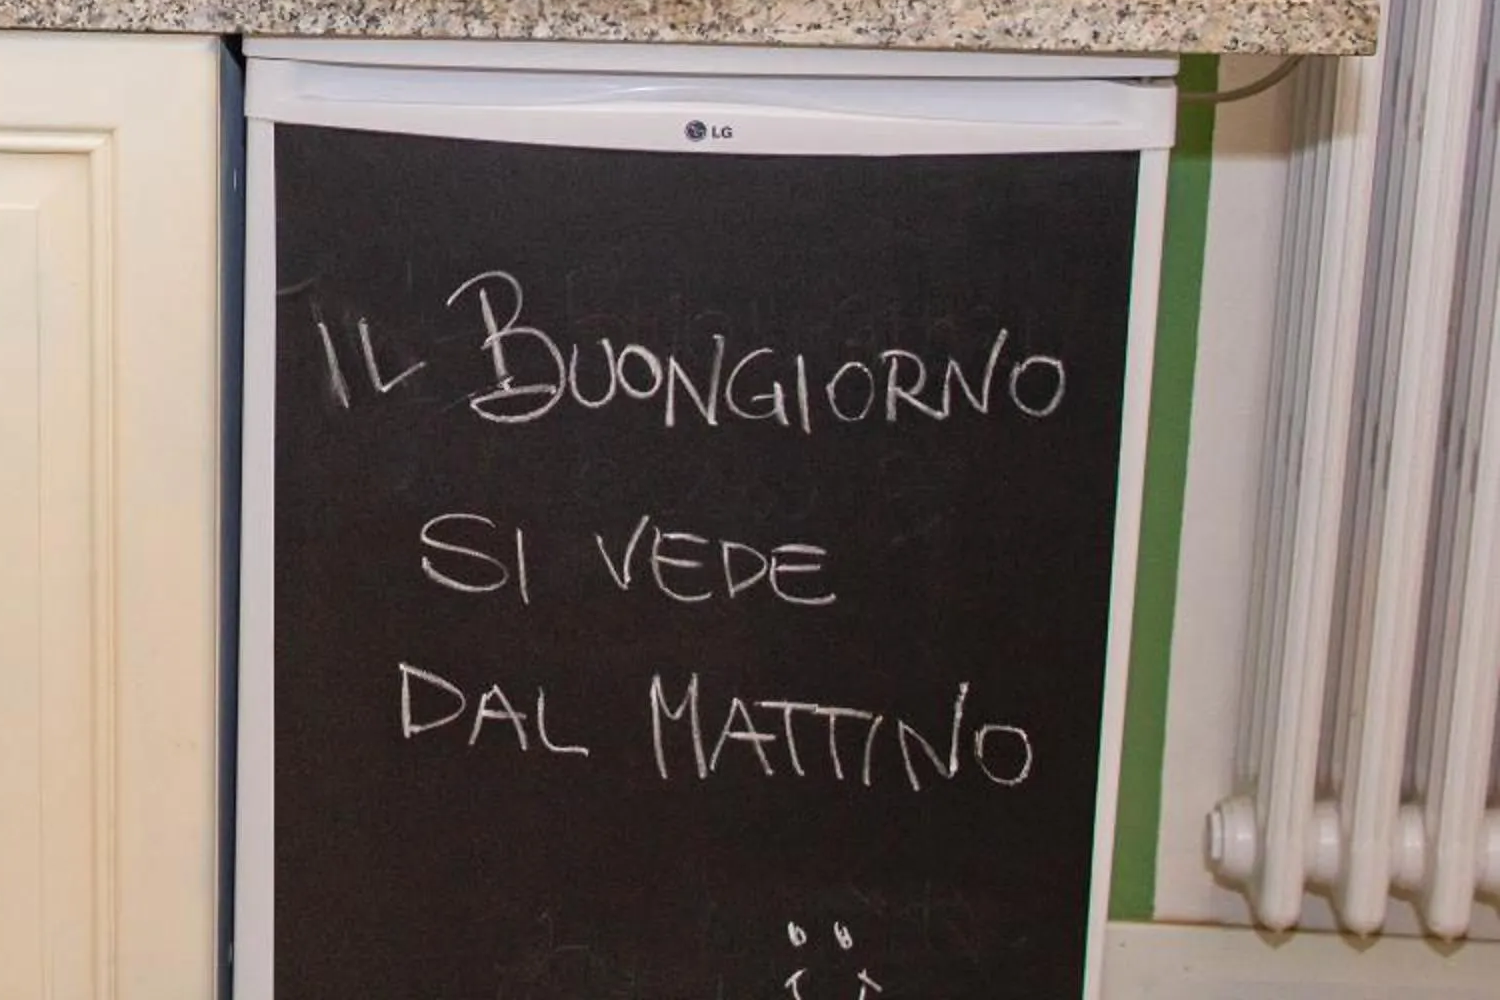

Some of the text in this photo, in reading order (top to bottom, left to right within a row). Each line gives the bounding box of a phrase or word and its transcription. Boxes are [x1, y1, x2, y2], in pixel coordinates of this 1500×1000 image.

[317, 270, 1065, 434] IL BUONGIORNO
[420, 513, 836, 605] SI VEDE
[398, 662, 1033, 791] DAL MATTINO
